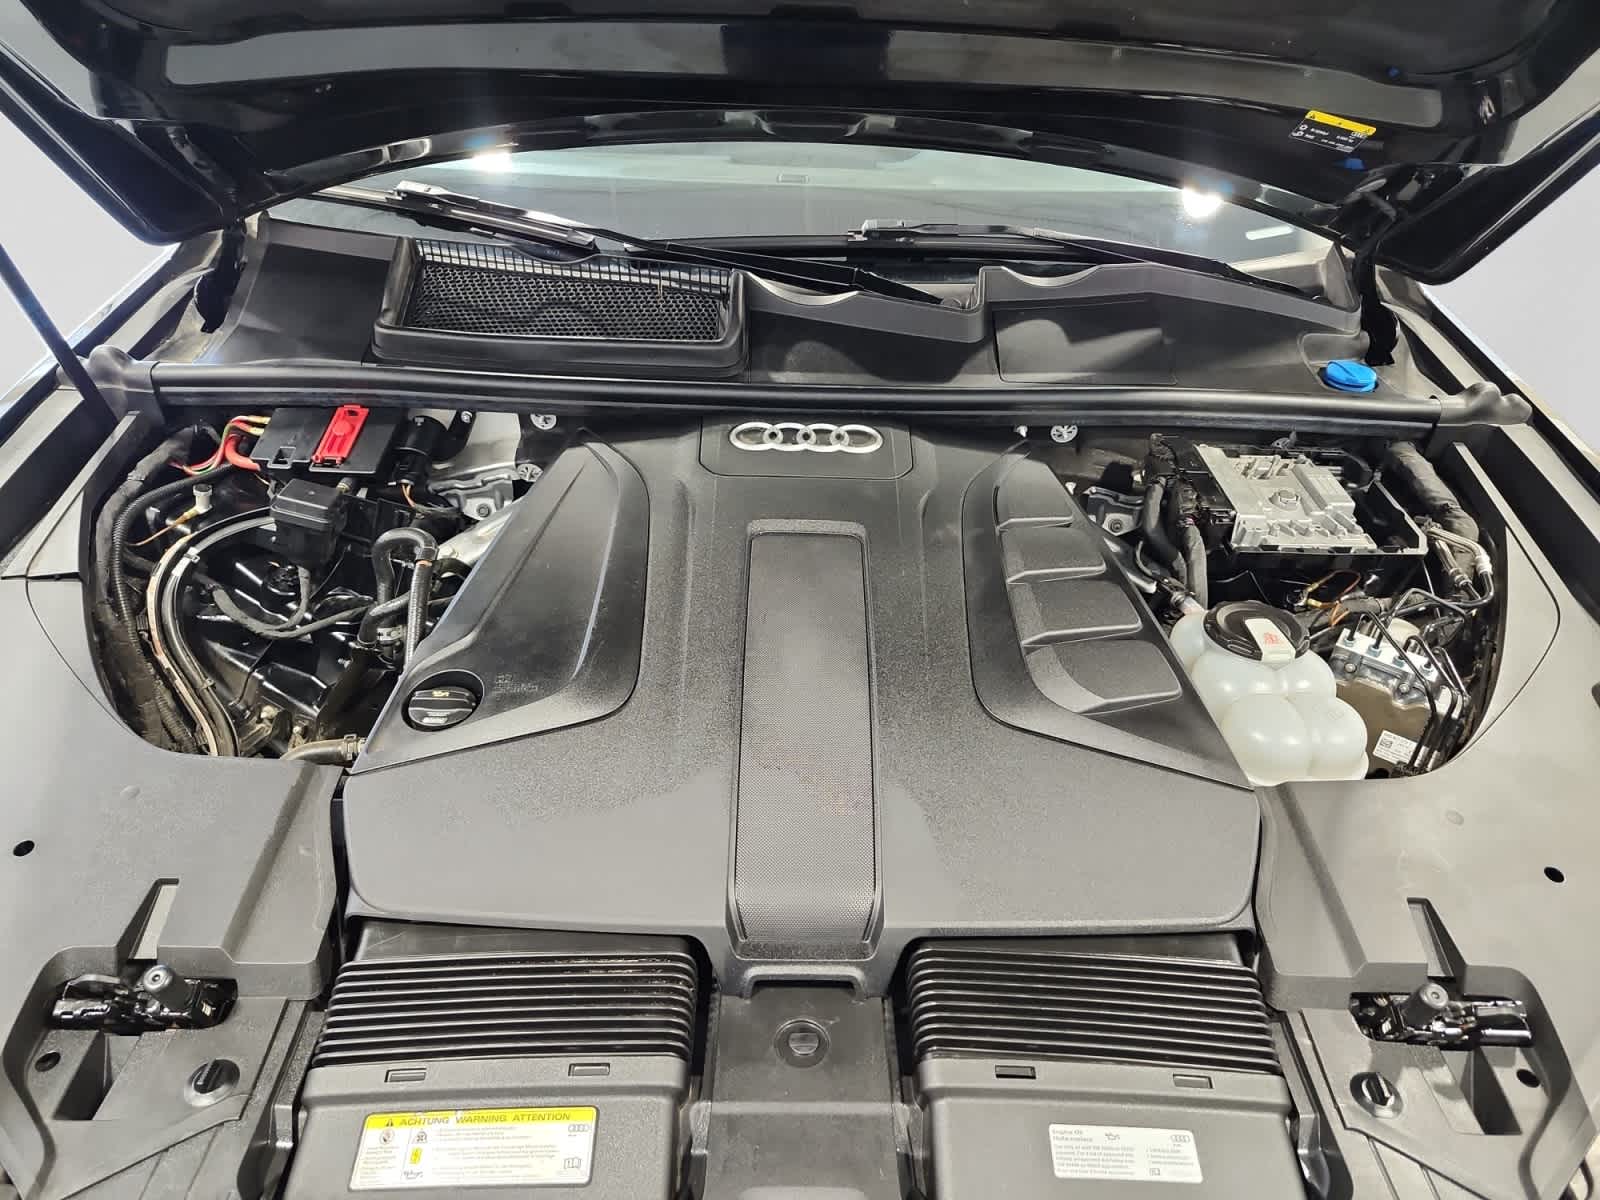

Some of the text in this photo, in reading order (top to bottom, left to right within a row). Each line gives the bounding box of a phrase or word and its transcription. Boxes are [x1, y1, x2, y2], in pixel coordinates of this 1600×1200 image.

[399, 1112, 571, 1126] ACHTUNG WARNING ATTENTION
